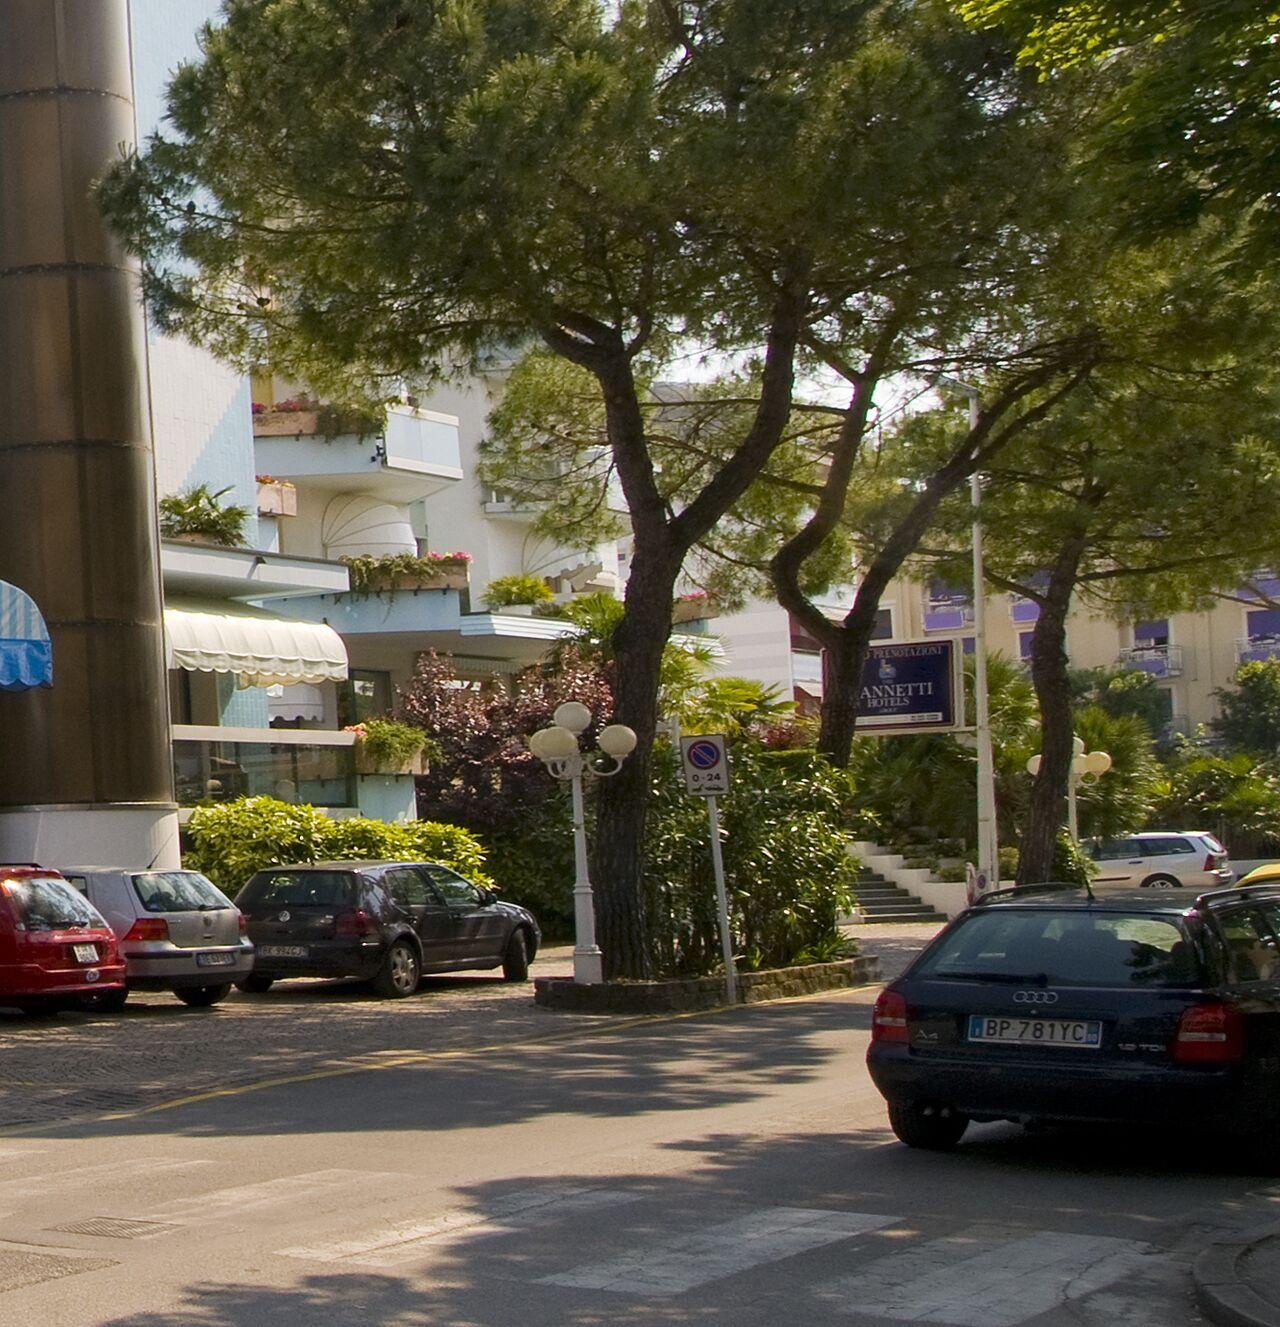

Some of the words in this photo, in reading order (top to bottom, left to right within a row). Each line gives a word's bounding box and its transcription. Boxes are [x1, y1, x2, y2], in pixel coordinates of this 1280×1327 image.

[860, 682, 934, 699] ANNETTI
[867, 697, 910, 708] HOTELS
[986, 1020, 1011, 1037] BP
[1018, 1022, 1085, 1041] 781YC
